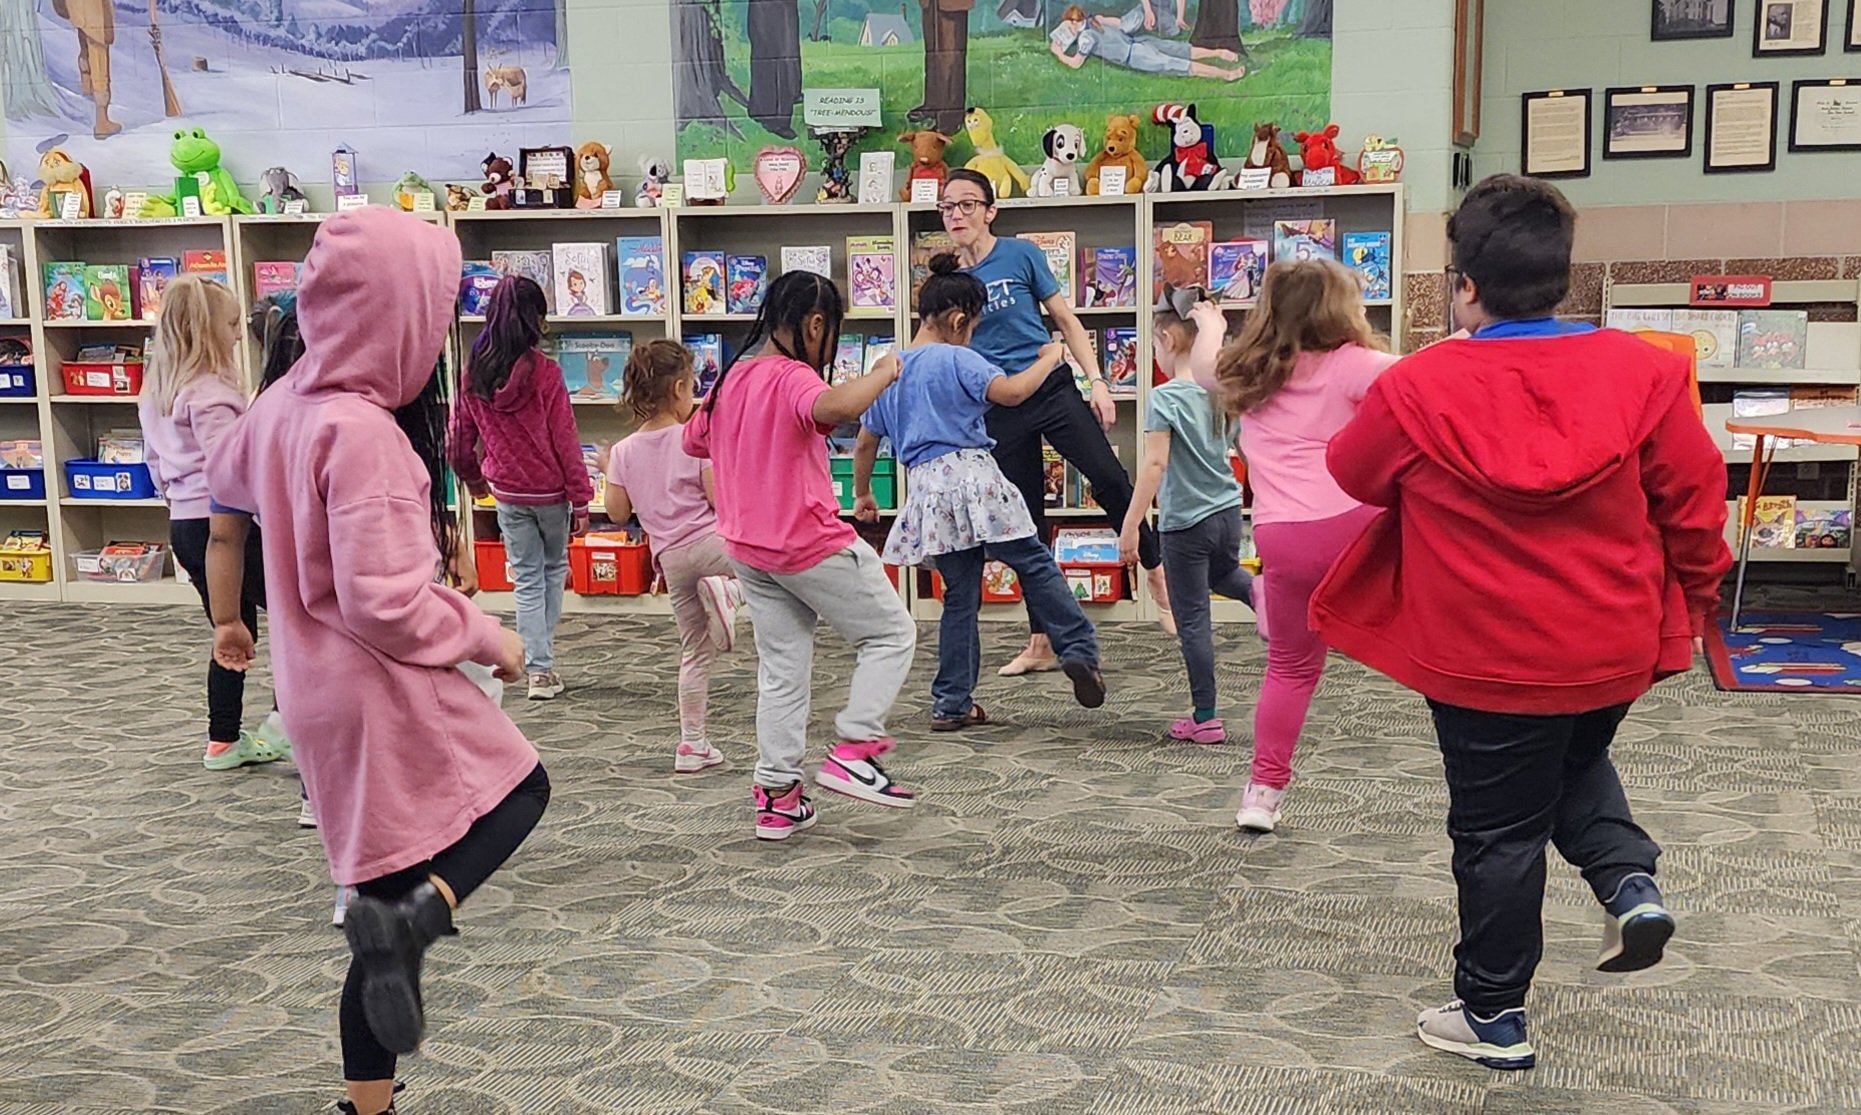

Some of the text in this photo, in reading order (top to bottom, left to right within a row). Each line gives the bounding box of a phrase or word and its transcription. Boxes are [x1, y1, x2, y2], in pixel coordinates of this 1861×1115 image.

[819, 96, 853, 105] READING
[1174, 231, 1193, 241] BEAR
[986, 278, 1014, 302] ET
[574, 340, 615, 349] Scooby-Doo
